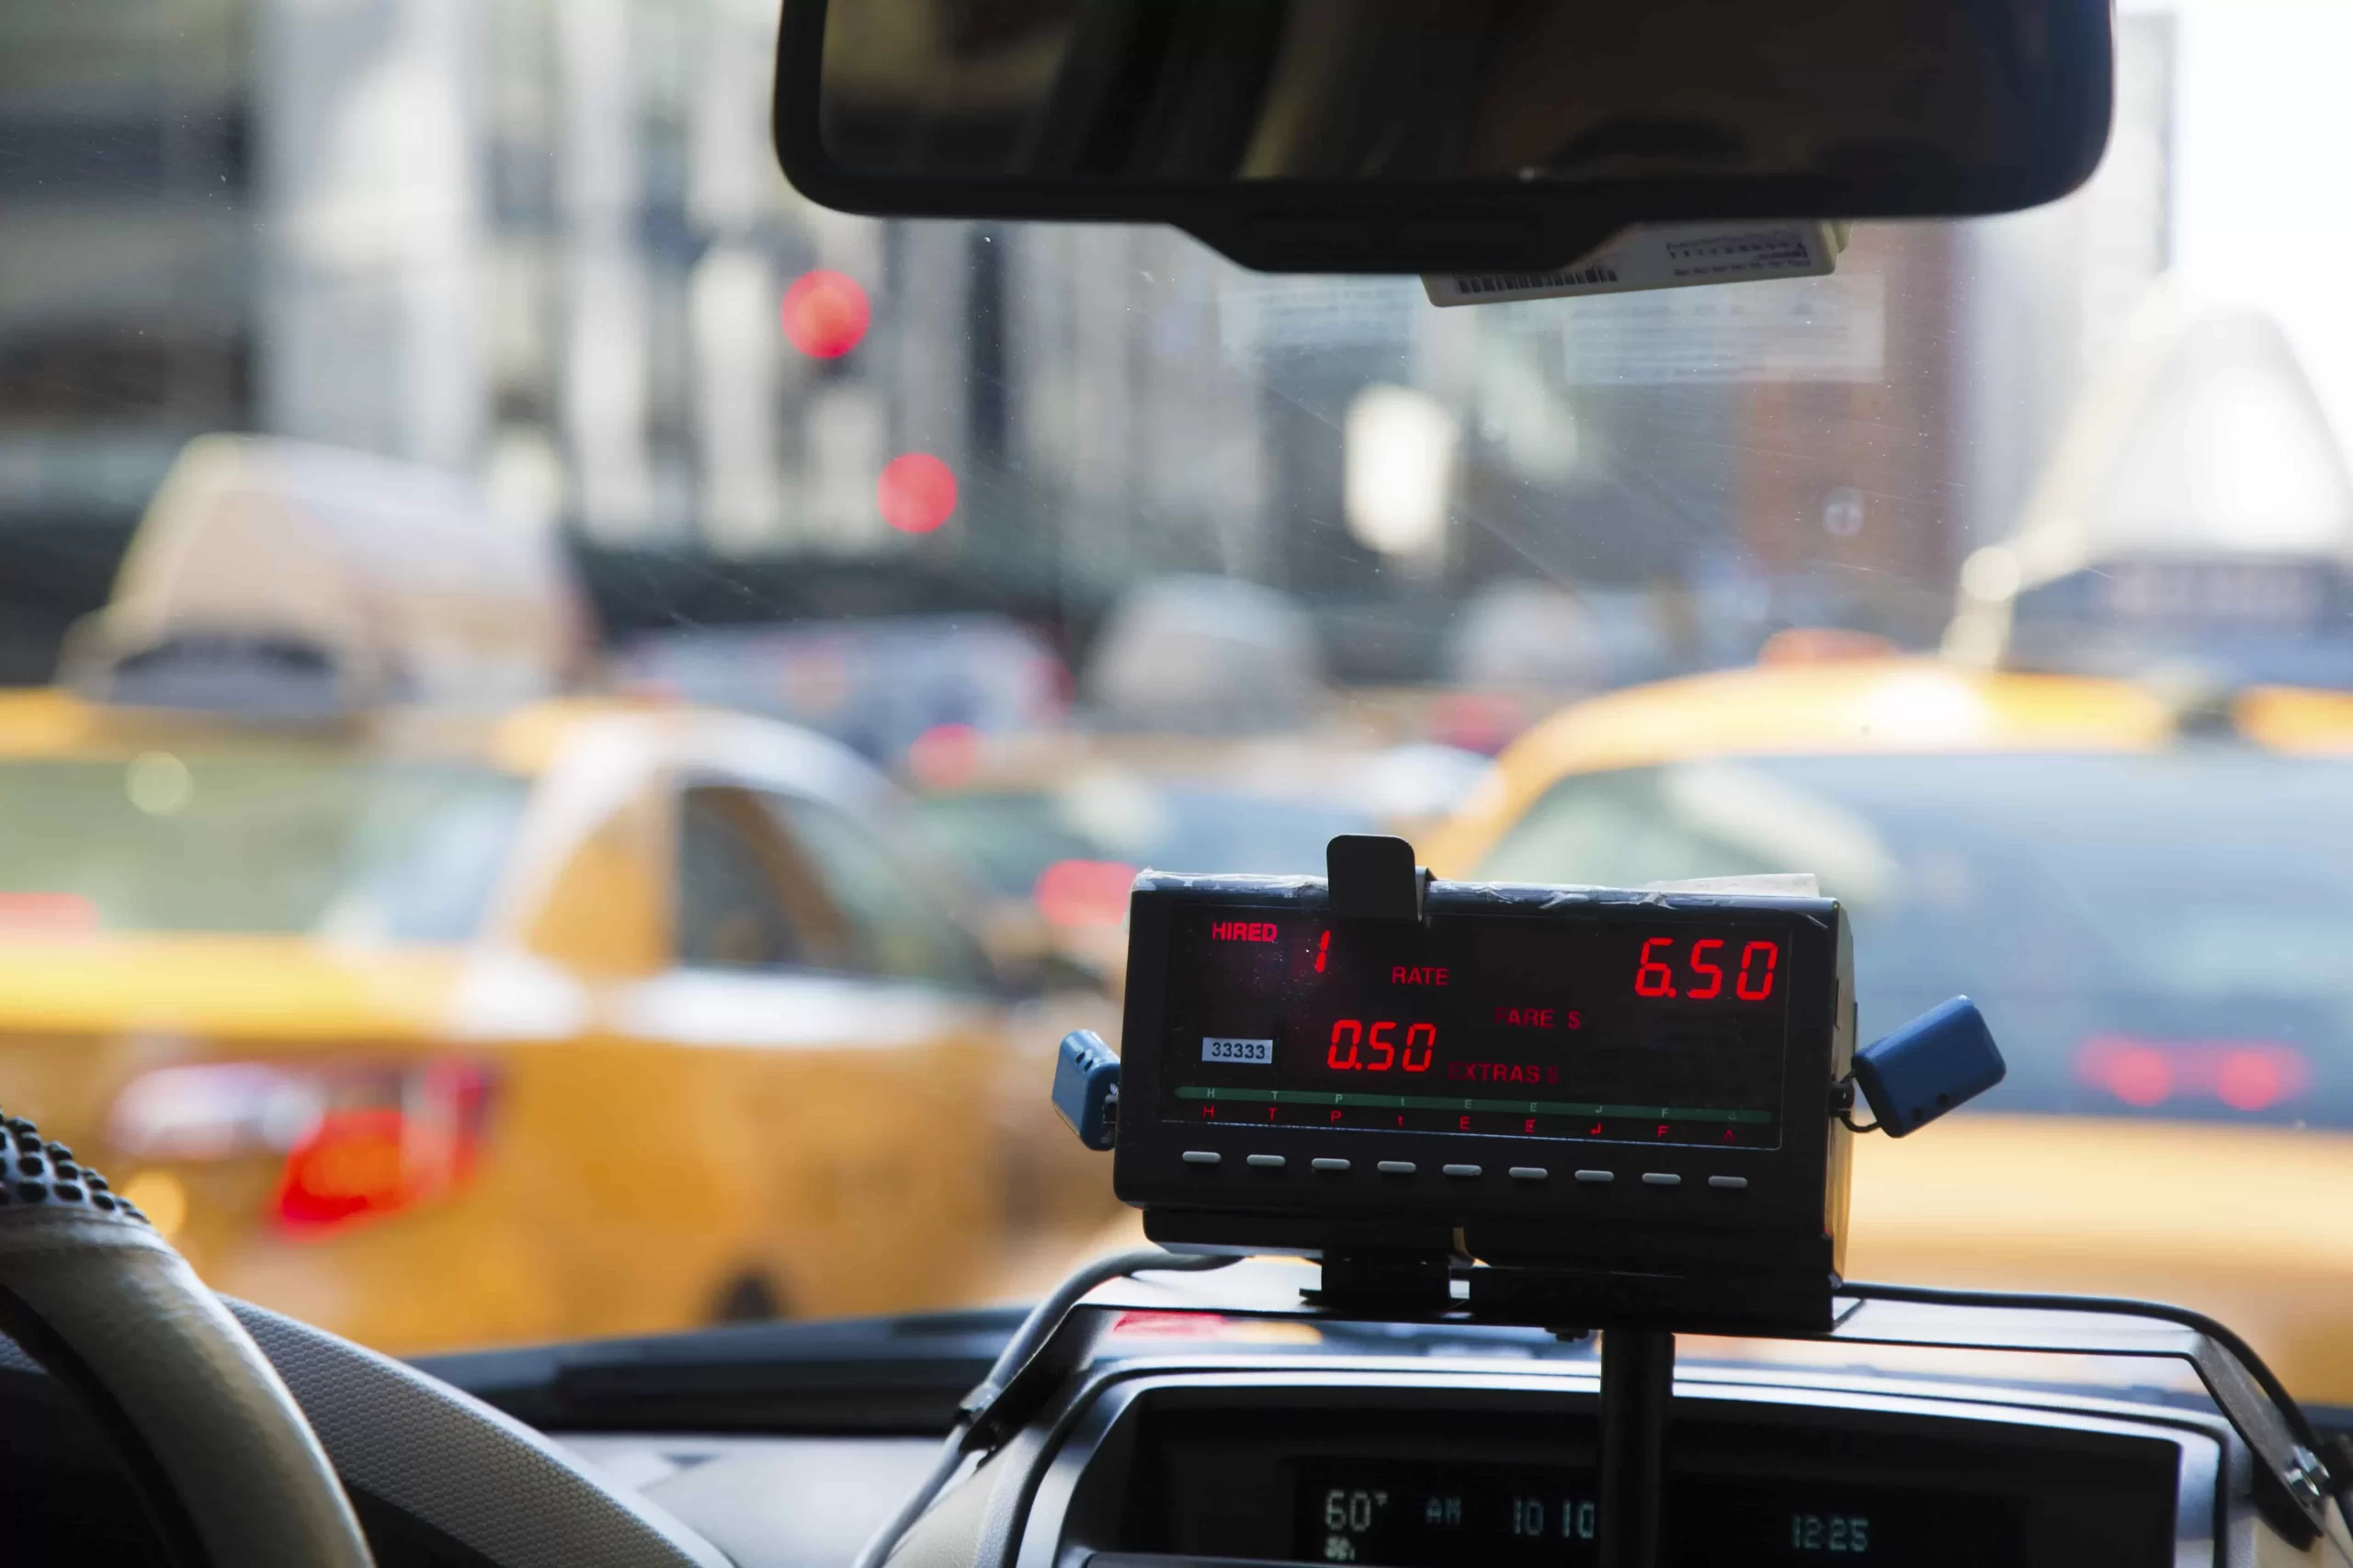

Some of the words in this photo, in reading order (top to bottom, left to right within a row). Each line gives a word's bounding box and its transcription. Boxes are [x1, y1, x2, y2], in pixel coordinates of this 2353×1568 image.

[1211, 921, 1278, 943] HIRED
[1314, 929, 1331, 974] 1
[1391, 965, 1449, 986] RATE
[1633, 937, 1779, 1001] 6.50
[1494, 1006, 1556, 1029] FARE
[1211, 1041, 1265, 1061] 33333
[1326, 1018, 1438, 1073] 0.50
[1448, 1061, 1541, 1085] EXTRAS
[1207, 1088, 1215, 1098] H
[1271, 1091, 1279, 1101] T
[1335, 1094, 1343, 1104] P
[1202, 1105, 1215, 1119] H
[1267, 1107, 1278, 1120] T
[1330, 1109, 1343, 1123] P
[1459, 1115, 1472, 1131] E
[1657, 1124, 1670, 1138] F
[1425, 1495, 1462, 1525] AM
